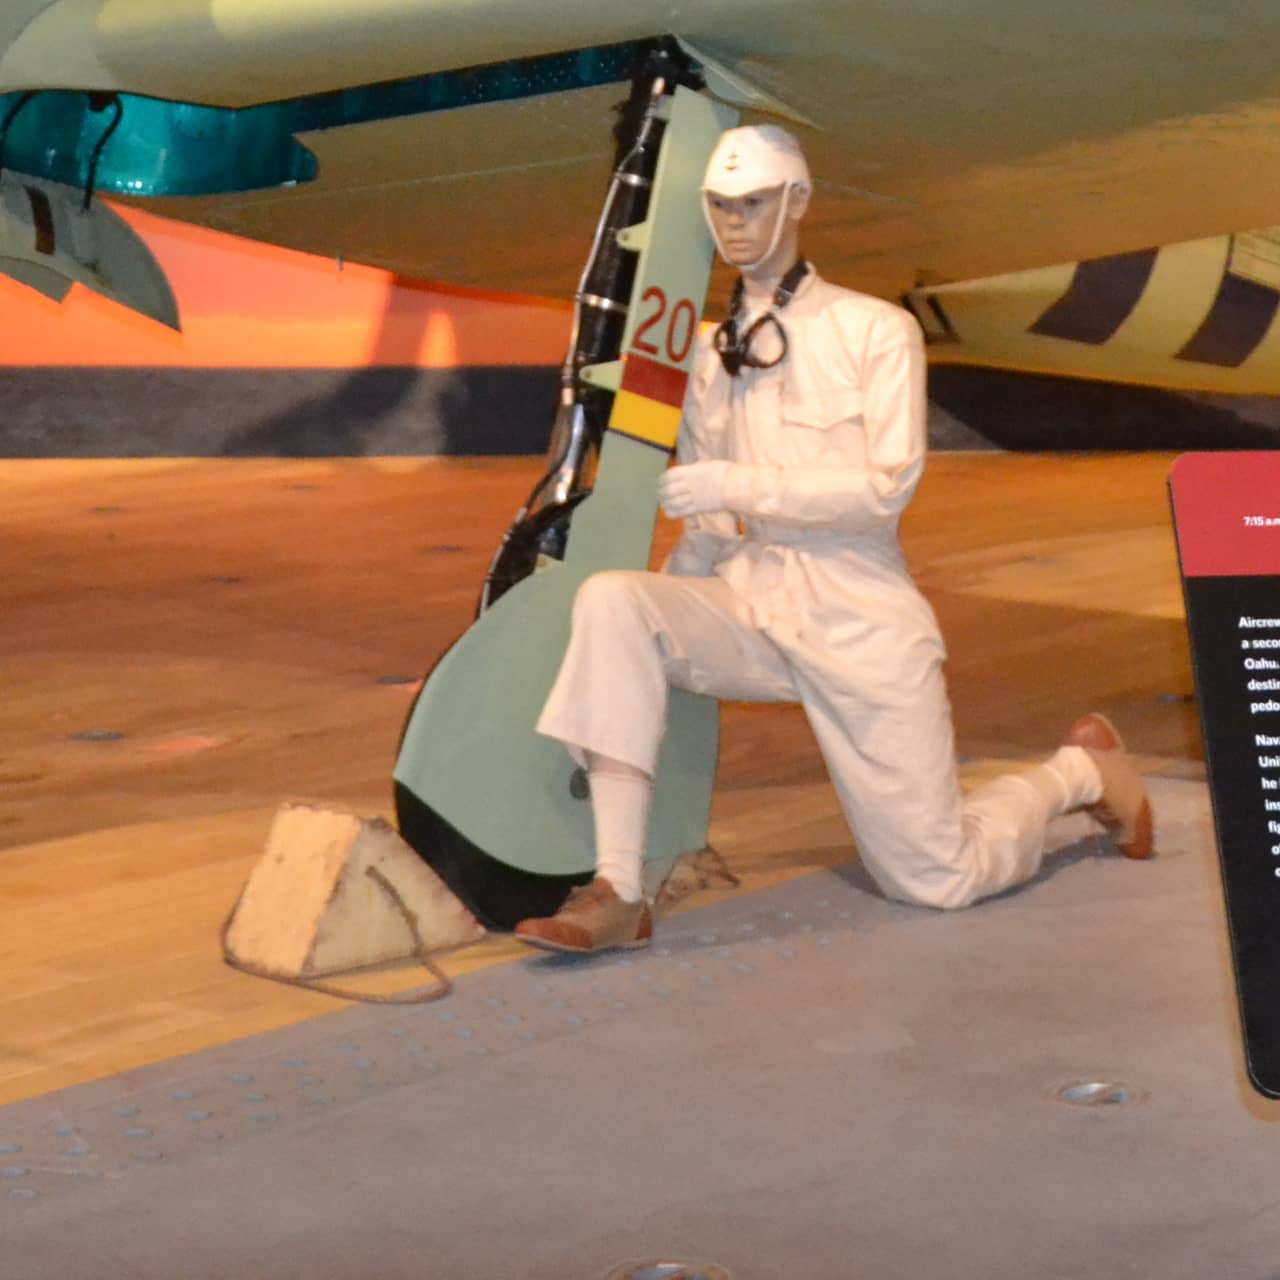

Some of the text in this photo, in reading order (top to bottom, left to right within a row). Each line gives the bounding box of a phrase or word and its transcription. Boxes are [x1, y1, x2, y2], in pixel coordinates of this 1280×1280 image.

[632, 286, 698, 363] 20
[1243, 515, 1265, 526] 7:15
[1240, 639, 1250, 649] a
